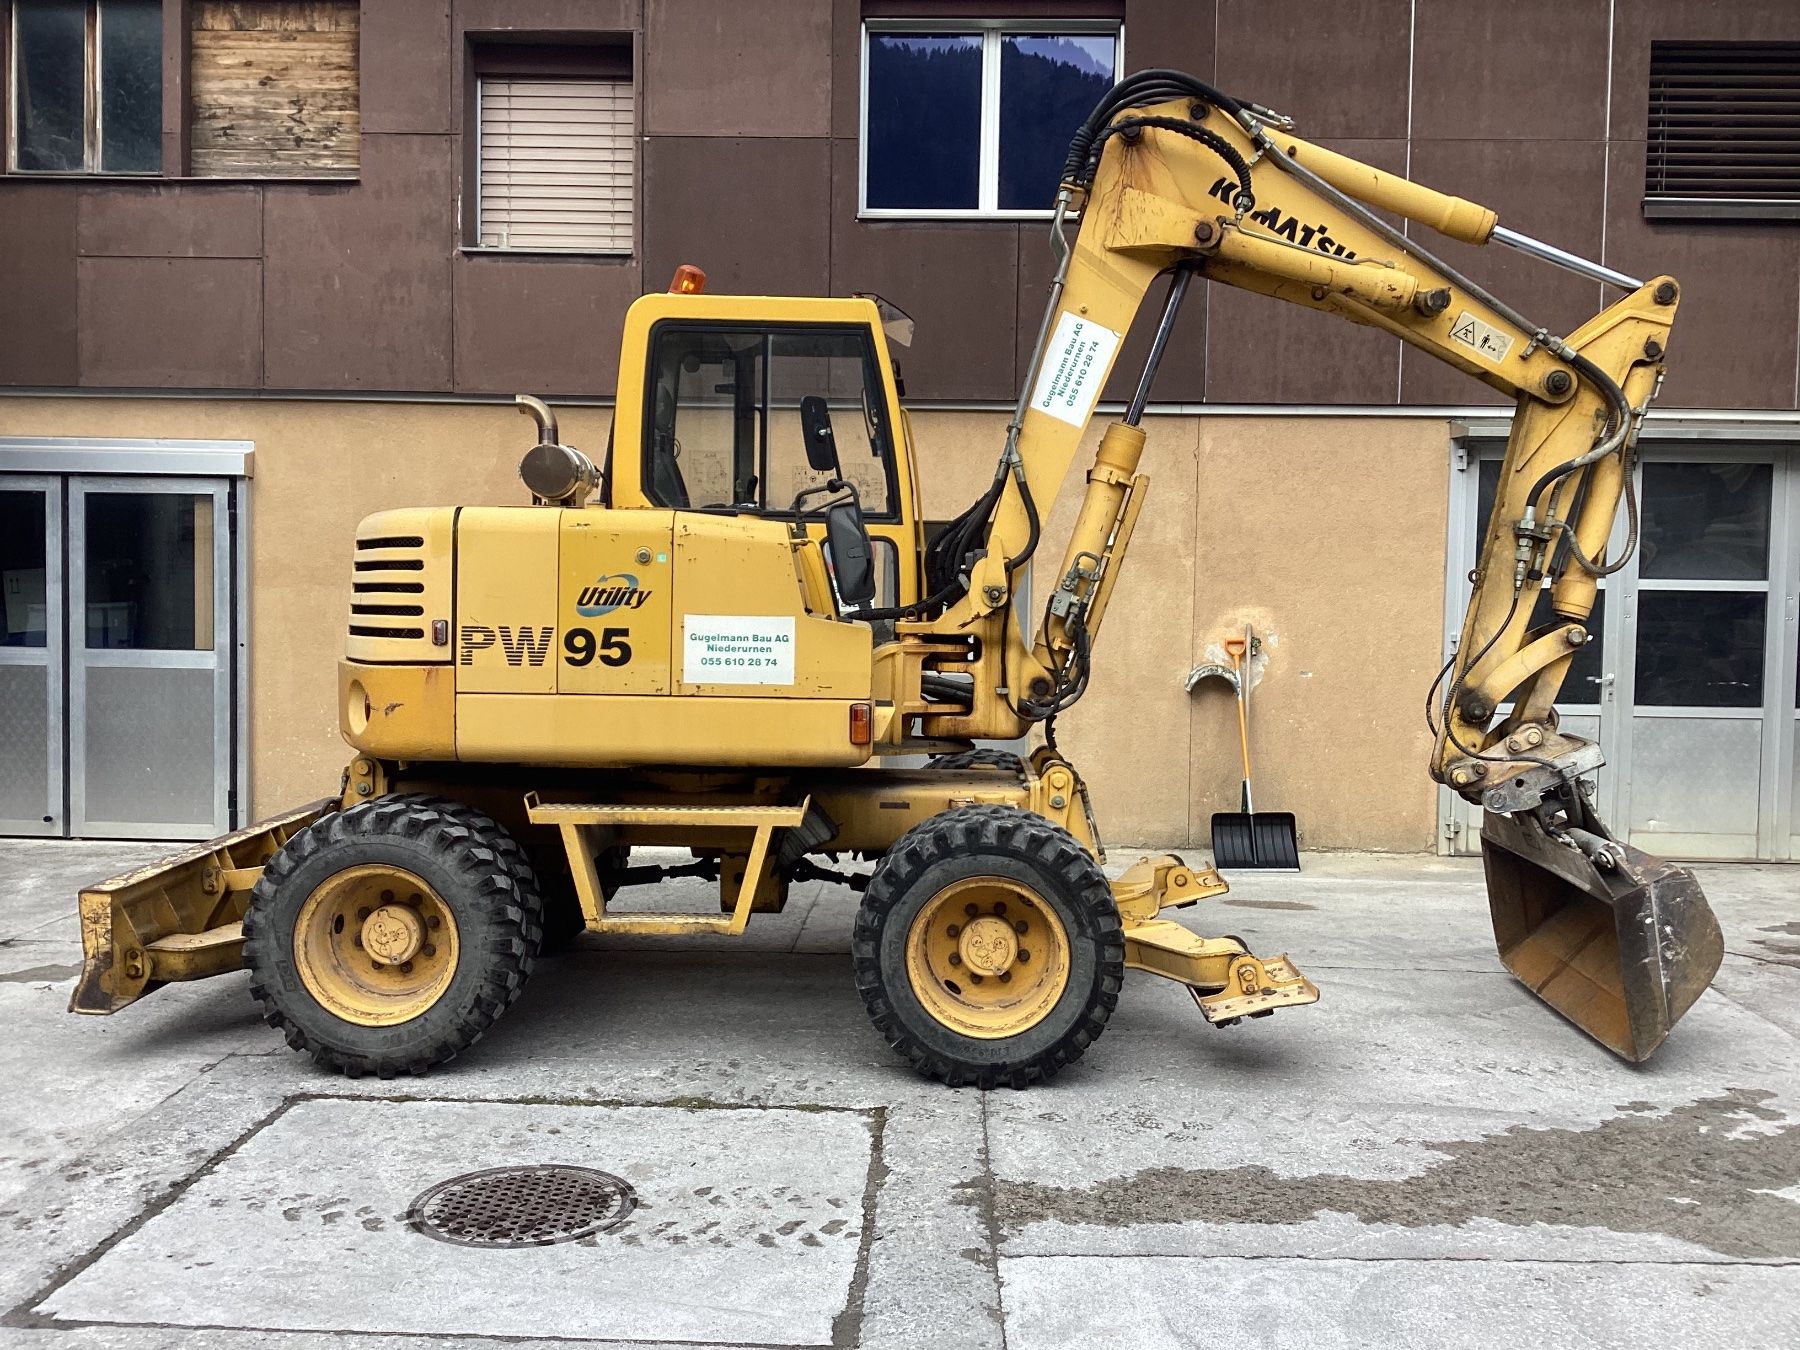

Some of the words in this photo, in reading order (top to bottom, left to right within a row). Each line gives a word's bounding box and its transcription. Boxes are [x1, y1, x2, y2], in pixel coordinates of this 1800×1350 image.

[1042, 357, 1069, 408] Gugelmann
[1064, 338, 1077, 356] Bau
[1073, 322, 1084, 337] AG
[1057, 341, 1086, 398] Niederurnen
[1066, 387, 1079, 407] 055
[1074, 368, 1087, 387] 610
[1083, 354, 1093, 368] 28
[1089, 340, 1099, 353] 74
[576, 586, 653, 609] Utility
[460, 625, 554, 666] PW
[563, 627, 633, 667] 95
[689, 632, 750, 643] Gugelmann
[752, 634, 772, 643] Bau
[774, 634, 790, 643] AG
[706, 644, 773, 653] Niederurnen
[700, 657, 722, 666] 055
[724, 657, 745, 666] 610
[747, 658, 762, 666] 28
[765, 658, 778, 667] 74
